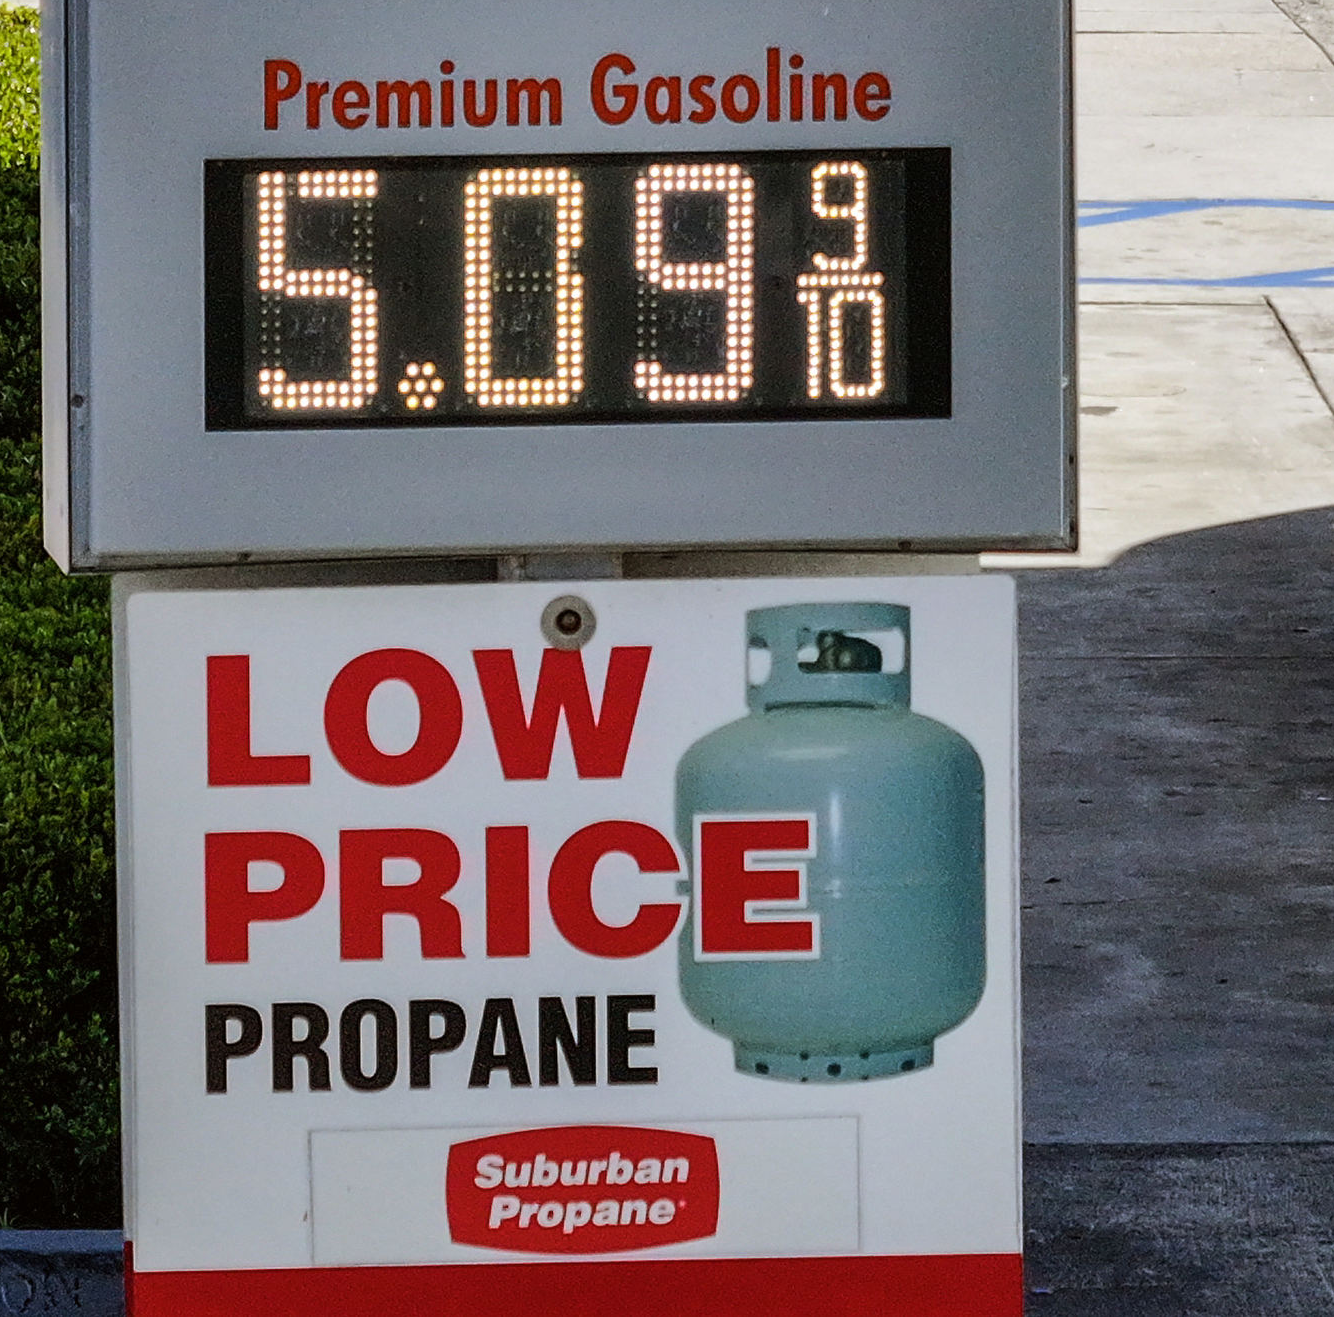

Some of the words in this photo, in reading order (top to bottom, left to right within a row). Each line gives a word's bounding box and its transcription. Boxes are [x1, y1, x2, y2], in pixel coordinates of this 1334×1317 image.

[263, 60, 562, 131] Premium
[590, 48, 892, 125] Gasoline
[205, 645, 652, 788] LOW
[205, 817, 815, 965] PRICE
[205, 994, 659, 1094] PROPANE
[474, 1153, 690, 1192] Suburban
[488, 1195, 676, 1231] Propane
